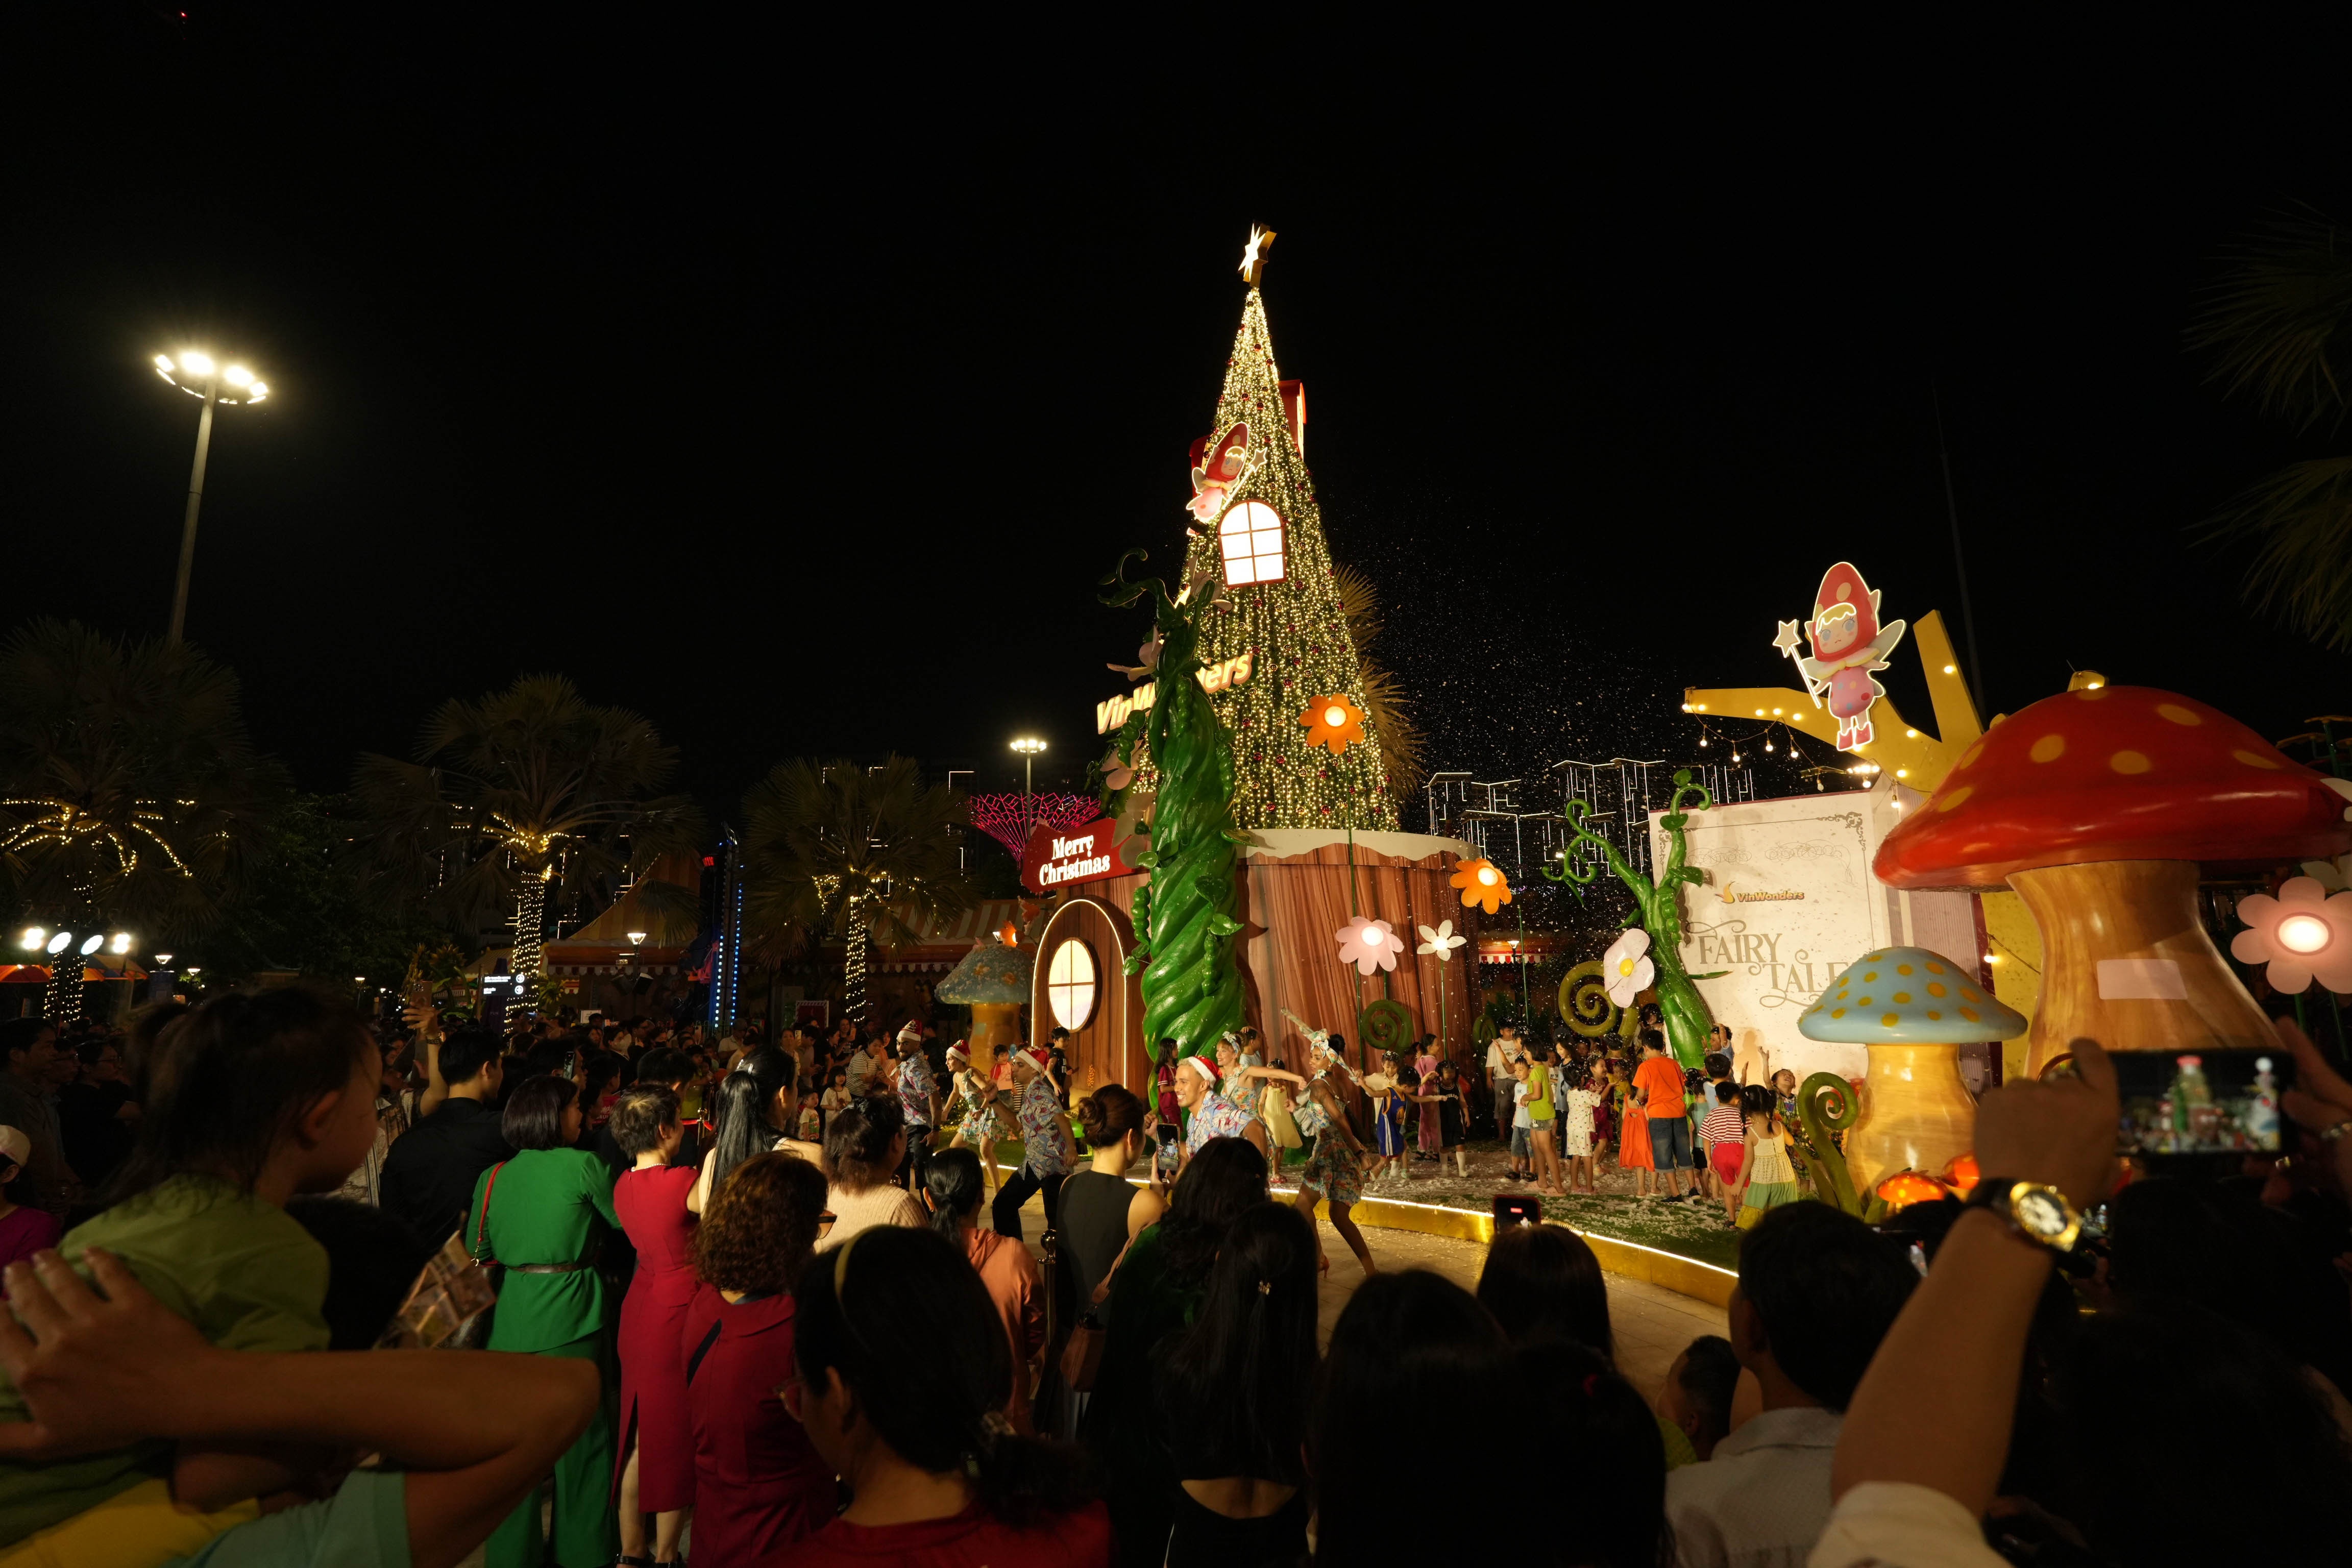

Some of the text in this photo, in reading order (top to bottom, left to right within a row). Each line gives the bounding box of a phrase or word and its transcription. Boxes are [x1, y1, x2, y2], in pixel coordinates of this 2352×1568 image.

[1051, 835, 1094, 860] Merry
[1039, 855, 1110, 886] Christmas
[1737, 891, 1804, 902] VinWonders
[1696, 930, 1782, 975] FAIRY
